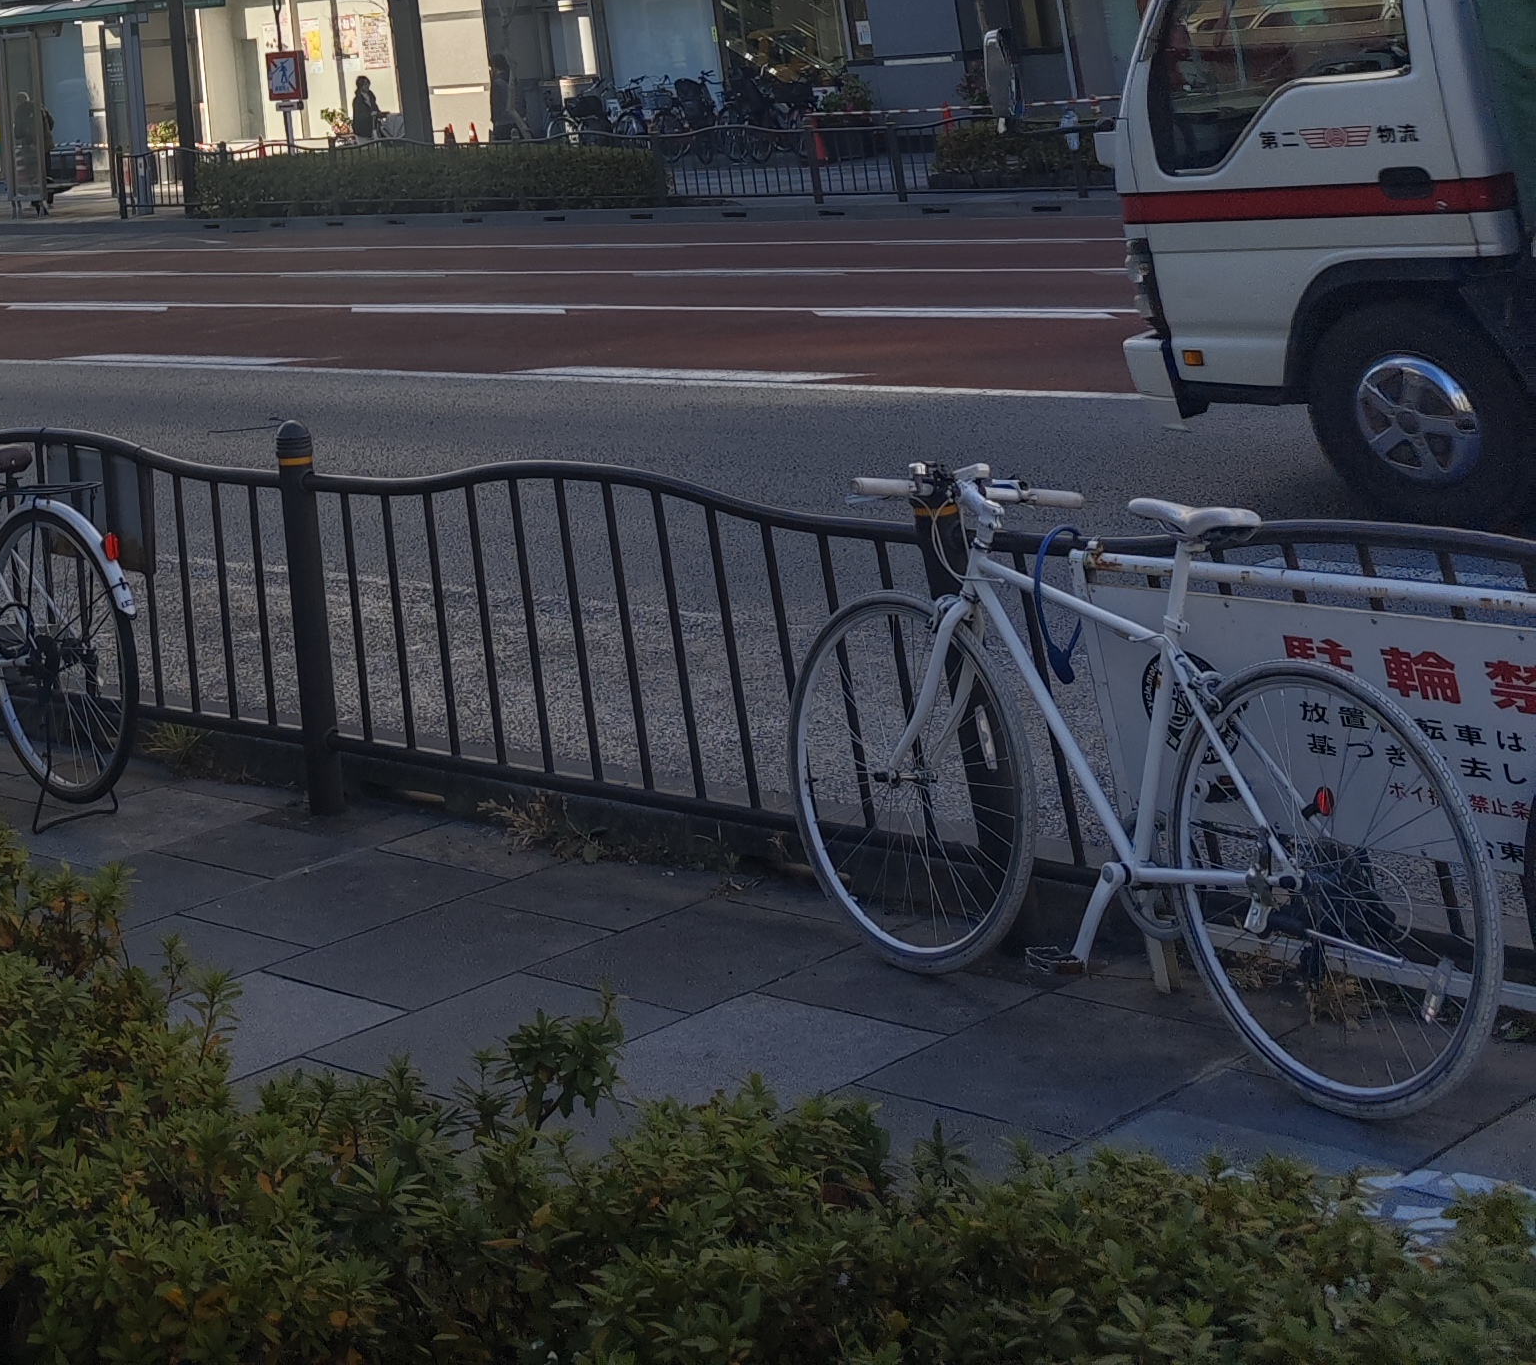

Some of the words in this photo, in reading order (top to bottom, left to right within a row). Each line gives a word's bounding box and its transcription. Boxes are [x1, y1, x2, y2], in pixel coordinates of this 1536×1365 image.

[1259, 131, 1300, 150] 第二
[1376, 123, 1421, 144] 物流
[1299, 700, 1527, 753] 放置転車は
[1306, 733, 1528, 785] 基づき去し
